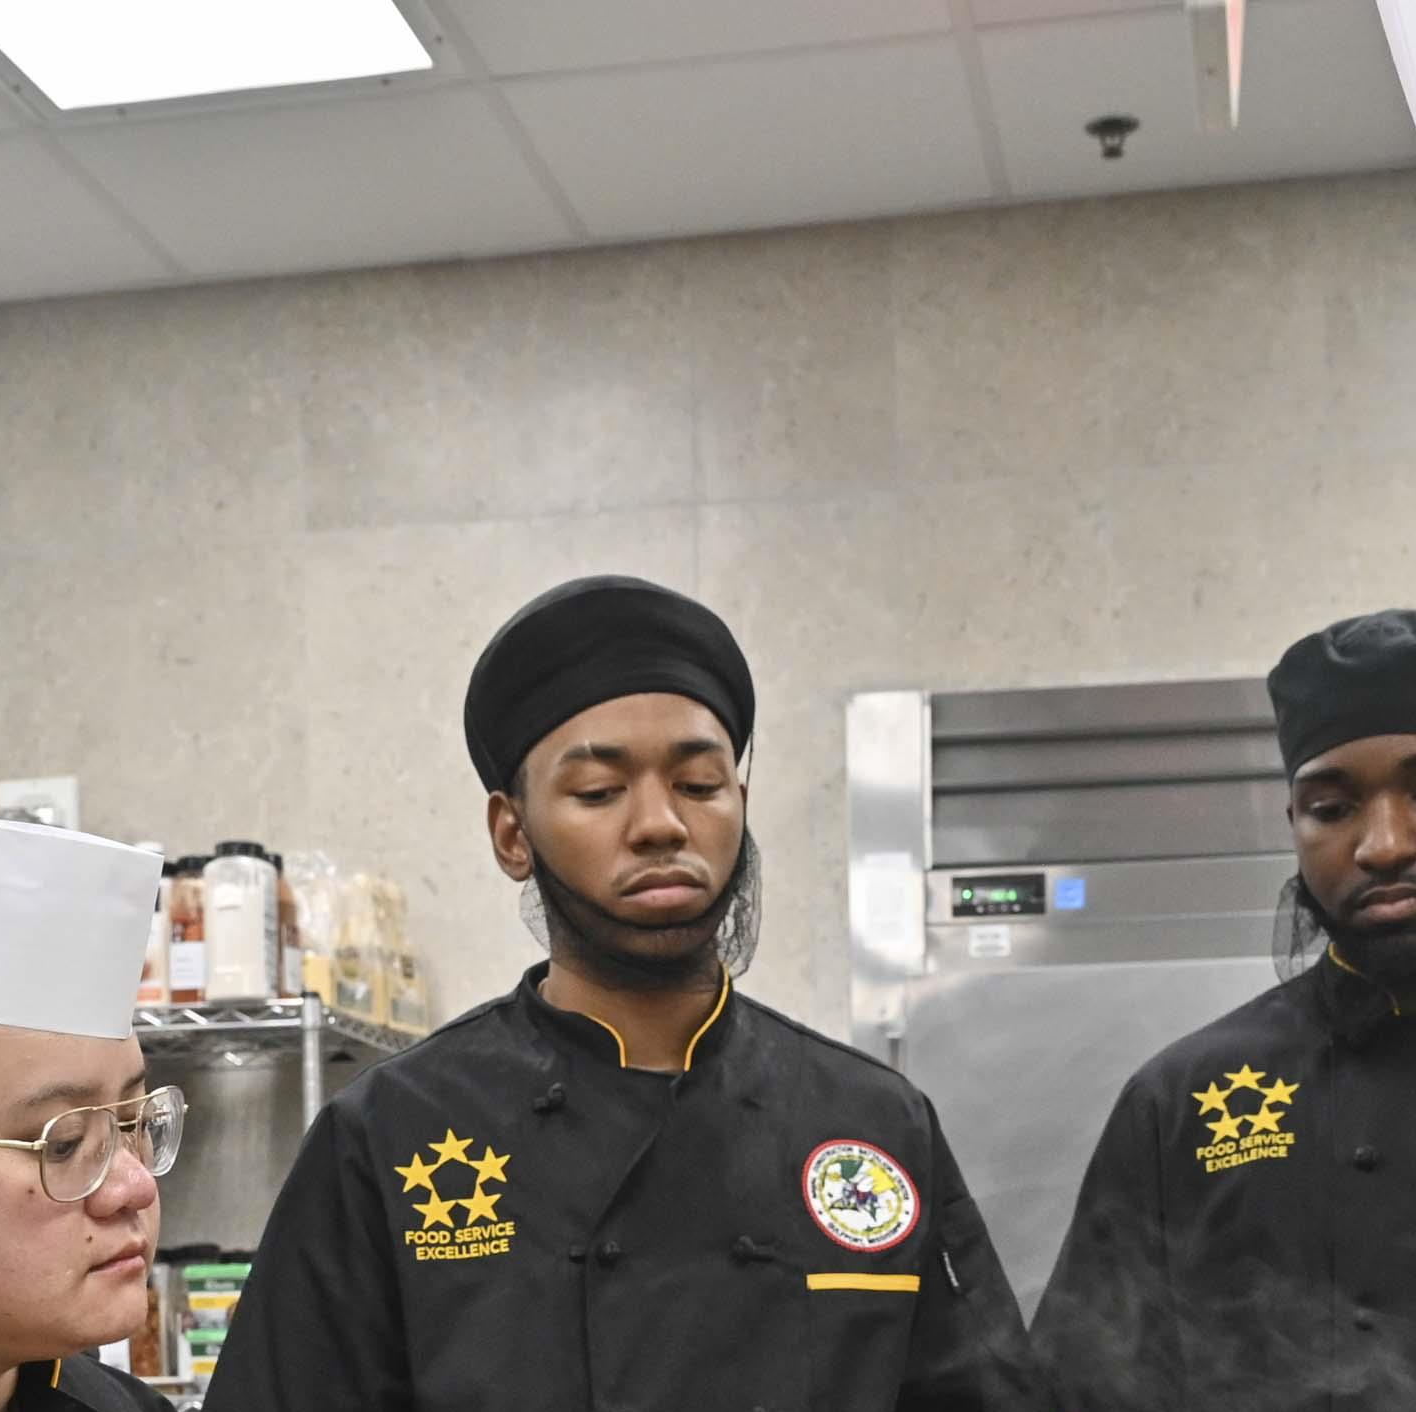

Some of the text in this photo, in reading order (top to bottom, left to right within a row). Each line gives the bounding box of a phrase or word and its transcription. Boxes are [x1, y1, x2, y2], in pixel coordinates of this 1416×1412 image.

[1196, 1132, 1295, 1160] FOOD SERVICE
[1205, 1146, 1288, 1173] EXCELLENCE
[405, 1221, 516, 1245] FOOD SERVICE
[415, 1238, 510, 1260] EXCELLENCE
